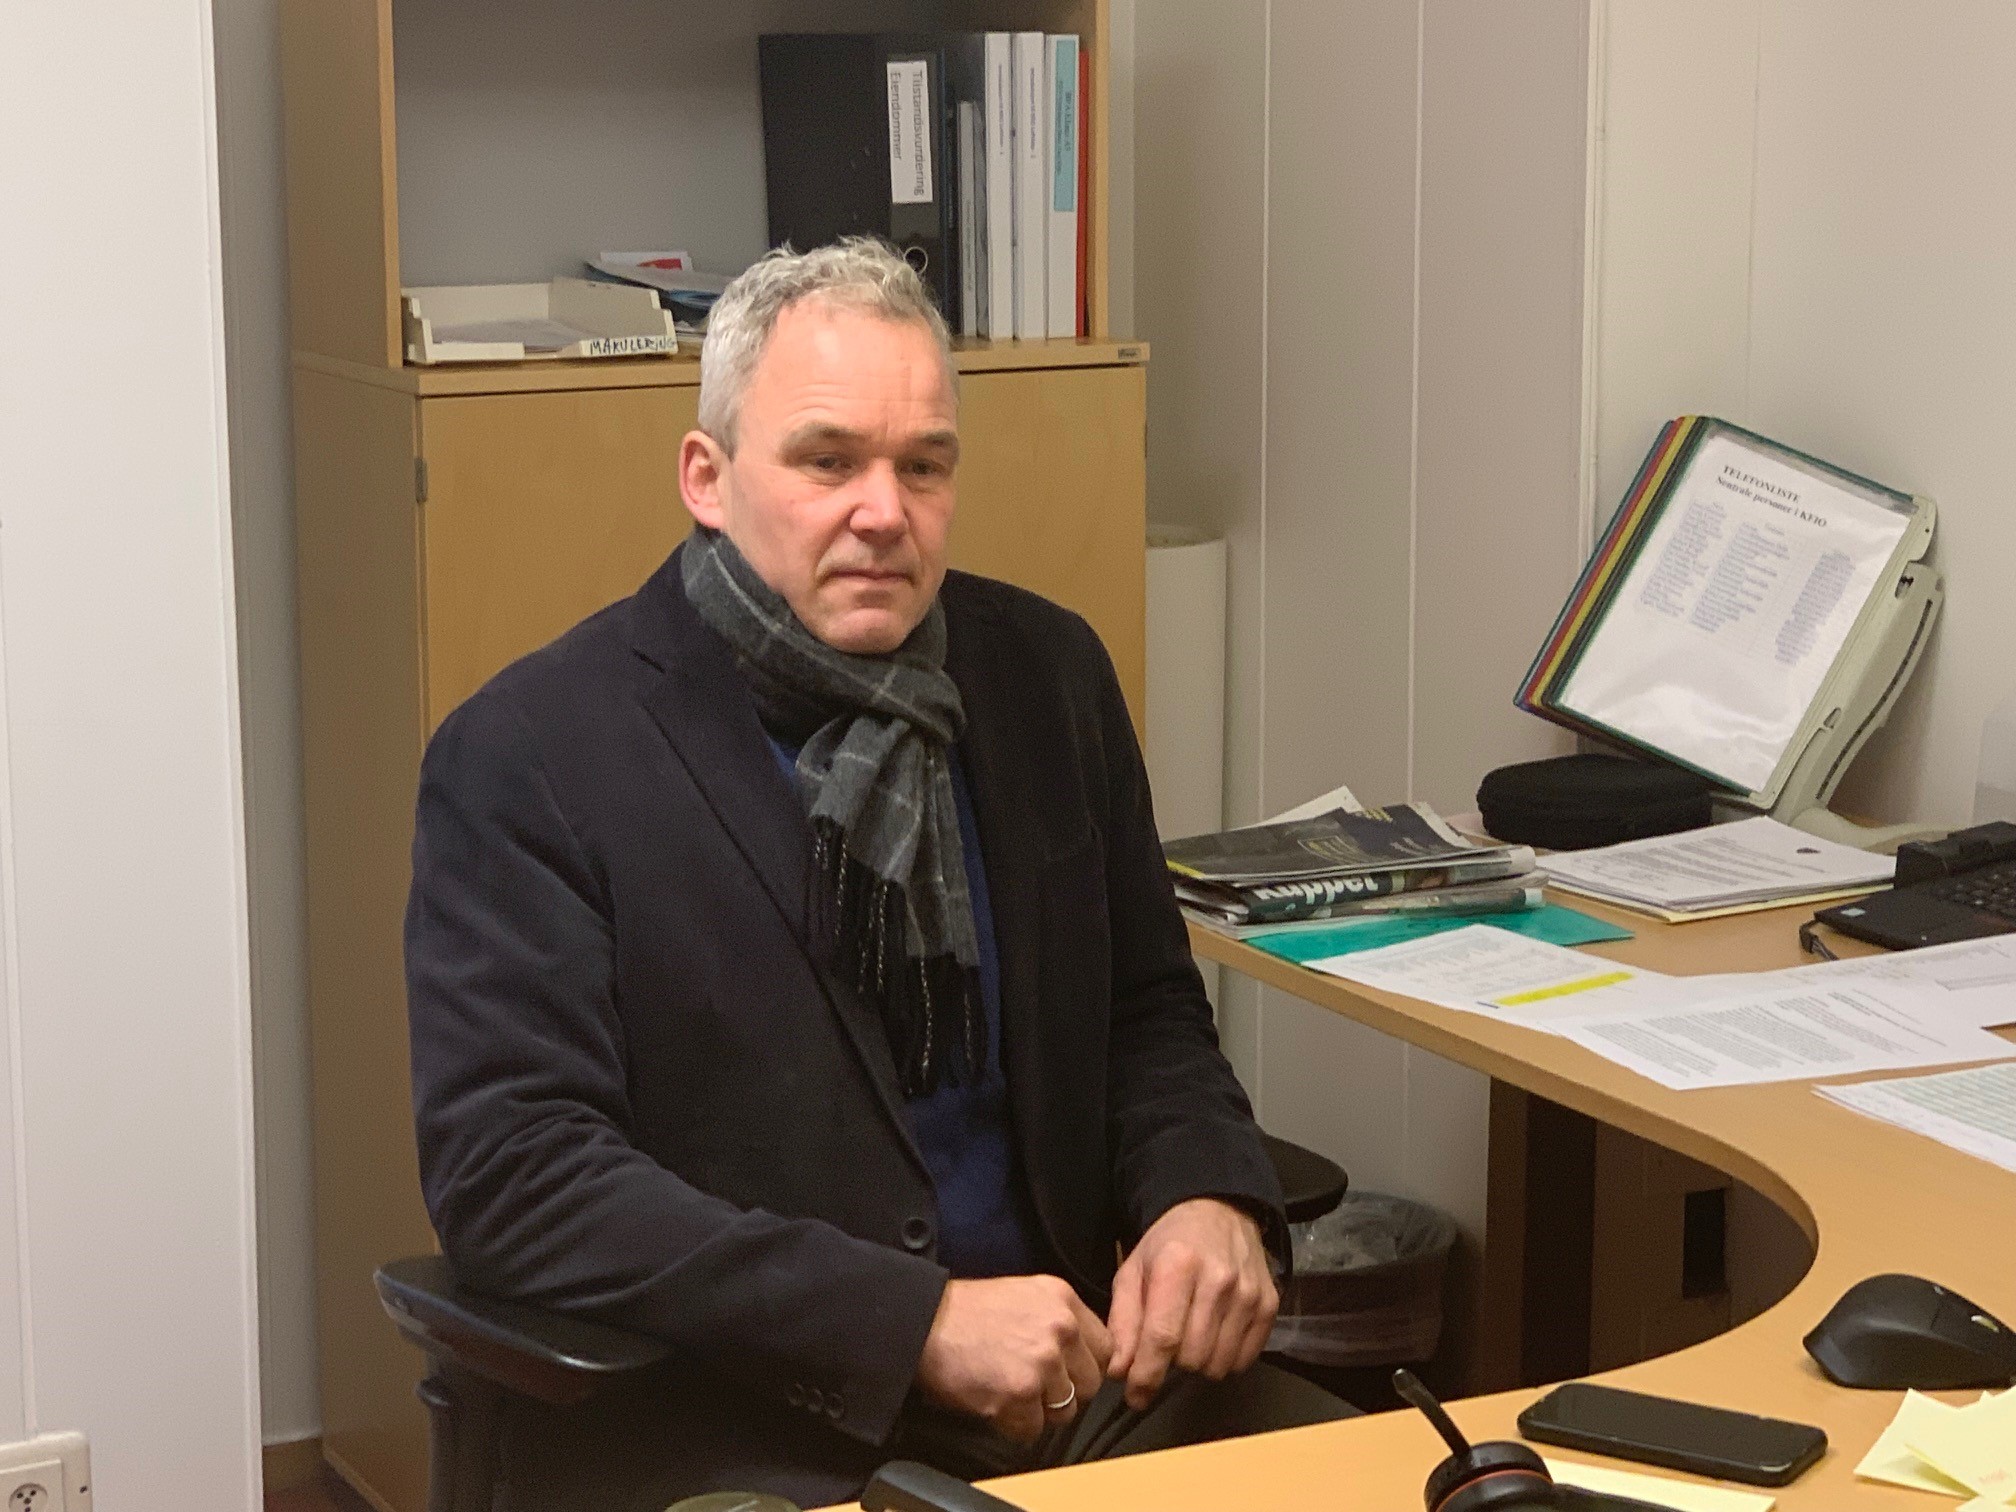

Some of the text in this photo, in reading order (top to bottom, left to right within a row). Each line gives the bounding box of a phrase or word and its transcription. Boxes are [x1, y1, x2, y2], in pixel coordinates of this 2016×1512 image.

[890, 71, 902, 160] Eiendommer
[912, 69, 925, 197] Tilstandsvurdering
[1723, 465, 1801, 503] TELEFONLISTE
[1752, 493, 1793, 515] personer
